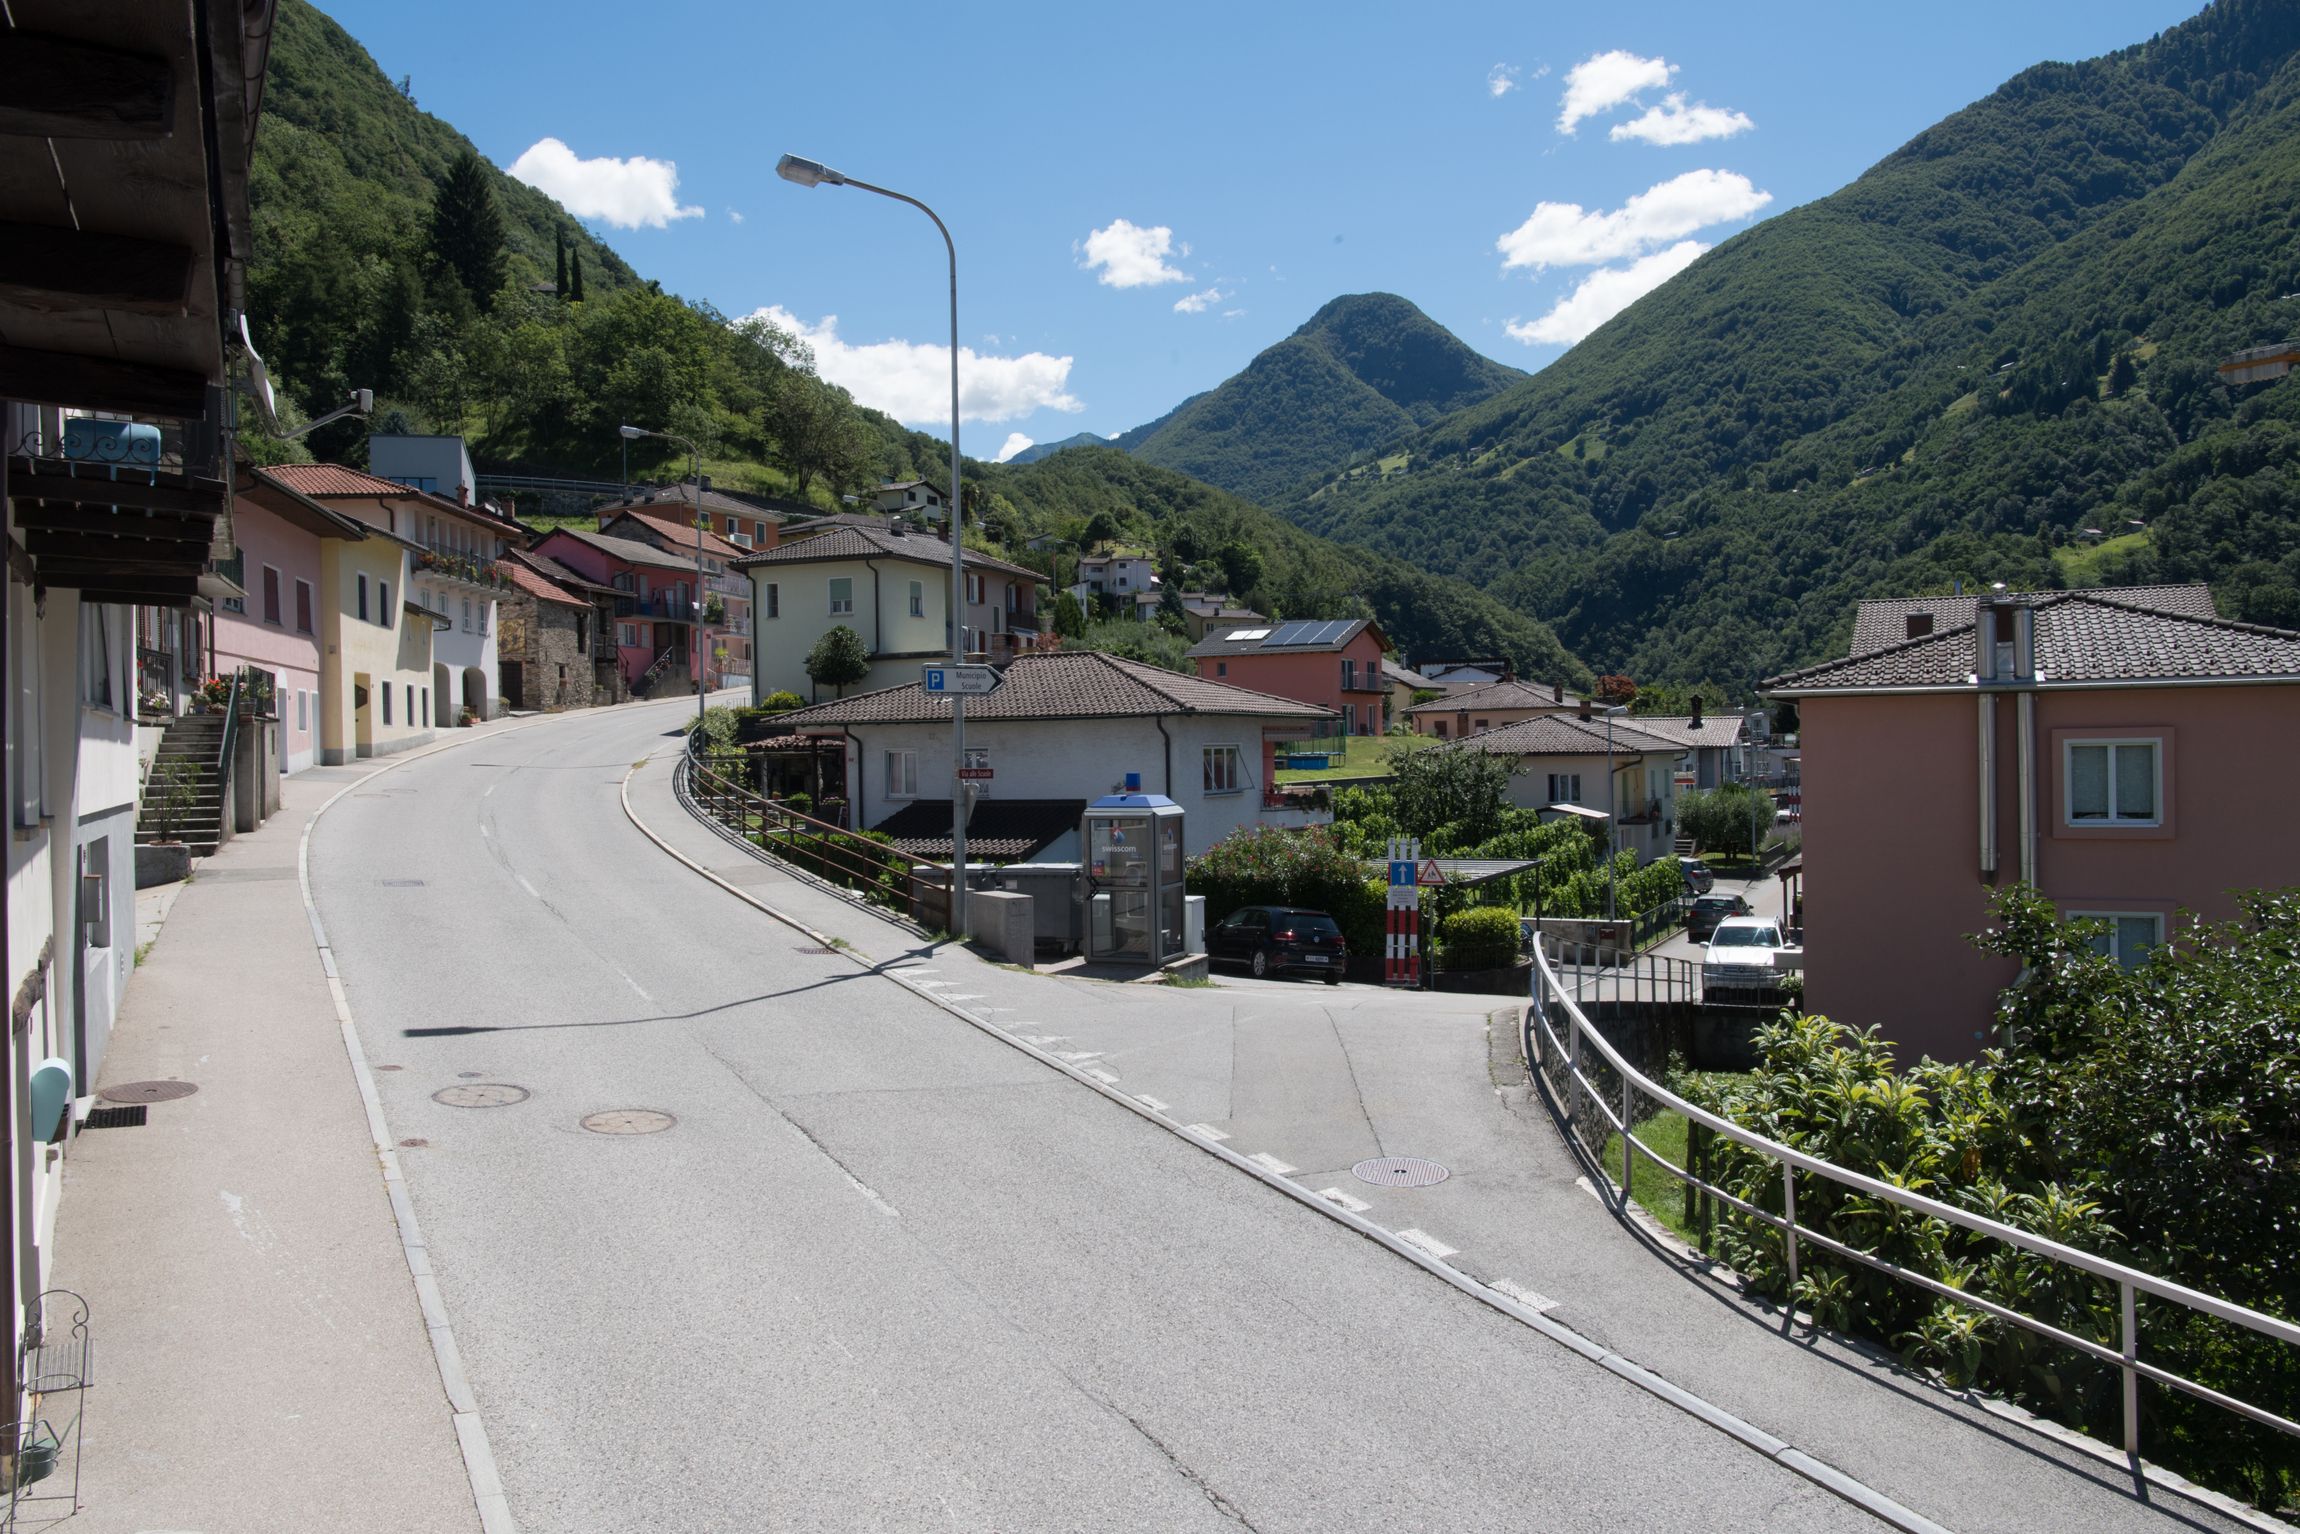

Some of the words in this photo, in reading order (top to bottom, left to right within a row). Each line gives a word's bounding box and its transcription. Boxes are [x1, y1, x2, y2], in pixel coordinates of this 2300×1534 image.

[931, 672, 940, 687] P
[956, 671, 987, 680] Municipio
[962, 681, 982, 690] Scuole
[977, 769, 992, 777] Scuole
[1101, 844, 1137, 853] swisscom
